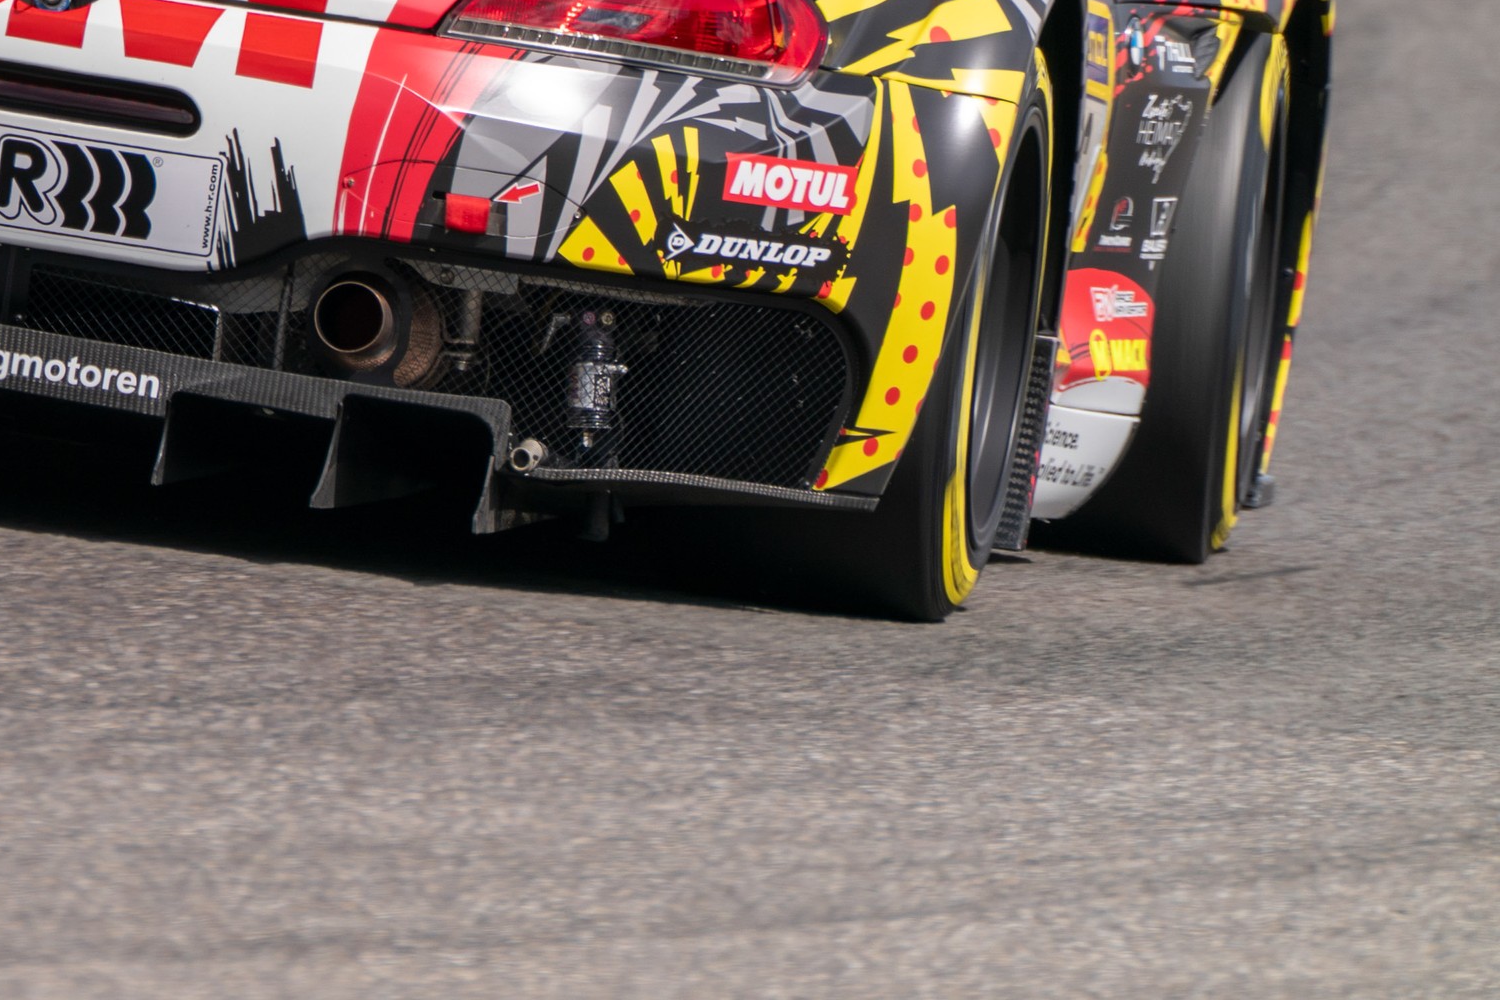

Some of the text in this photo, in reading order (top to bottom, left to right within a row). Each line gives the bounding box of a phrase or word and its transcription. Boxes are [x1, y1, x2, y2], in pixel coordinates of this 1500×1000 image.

[202, 163, 219, 249] www.h-r.com
[729, 160, 849, 208] MOTUL
[693, 232, 831, 267] DUNLOP
